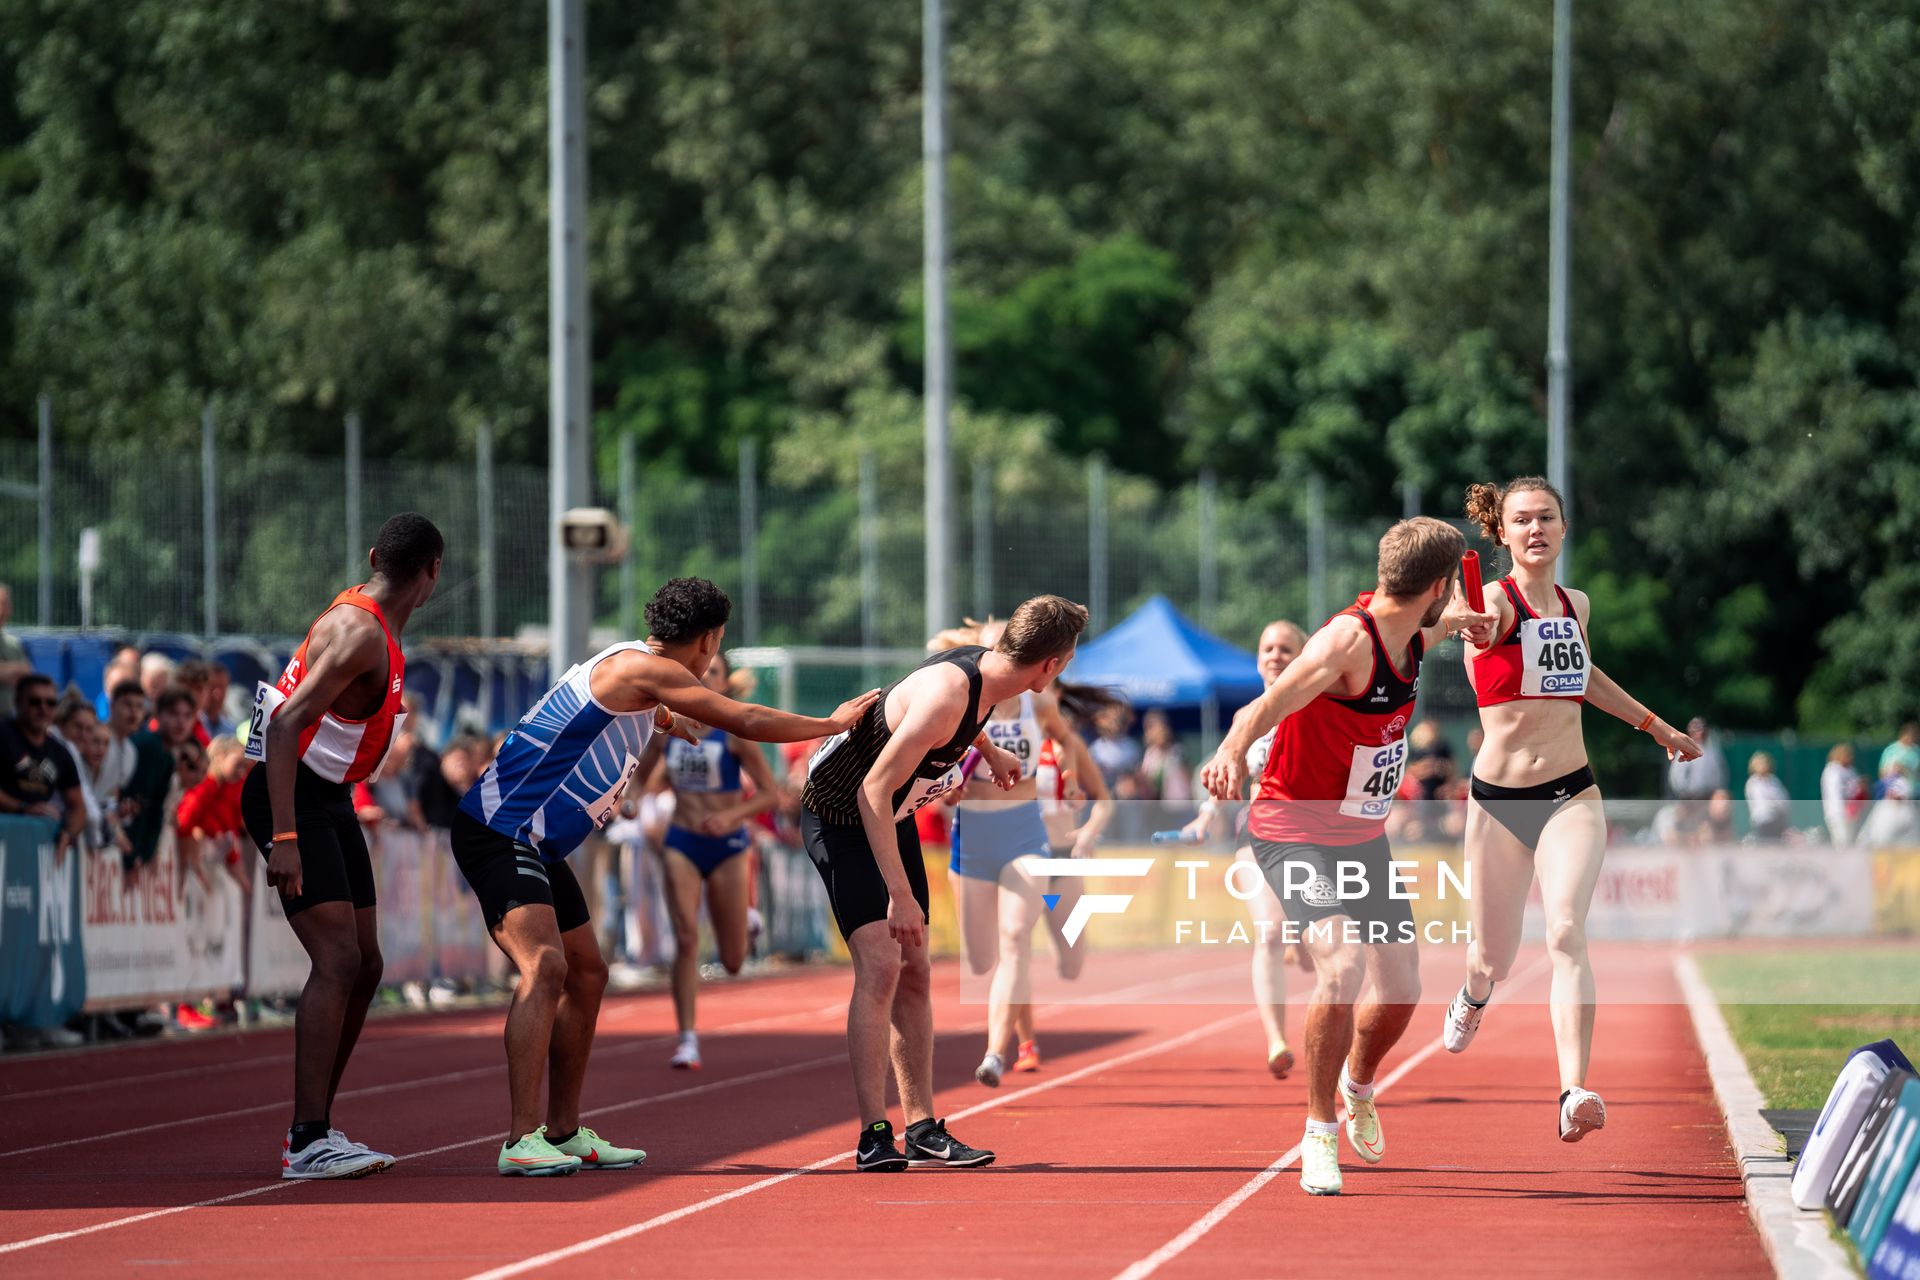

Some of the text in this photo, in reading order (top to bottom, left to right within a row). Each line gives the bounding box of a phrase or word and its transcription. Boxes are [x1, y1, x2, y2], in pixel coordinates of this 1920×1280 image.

[1538, 621, 1574, 640] GLS
[1538, 641, 1584, 671] 466
[1559, 676, 1583, 686] PLAN
[990, 723, 1022, 739] GLS
[993, 739, 1030, 760] 69
[1372, 743, 1404, 769] GLS
[1362, 762, 1403, 797] 465
